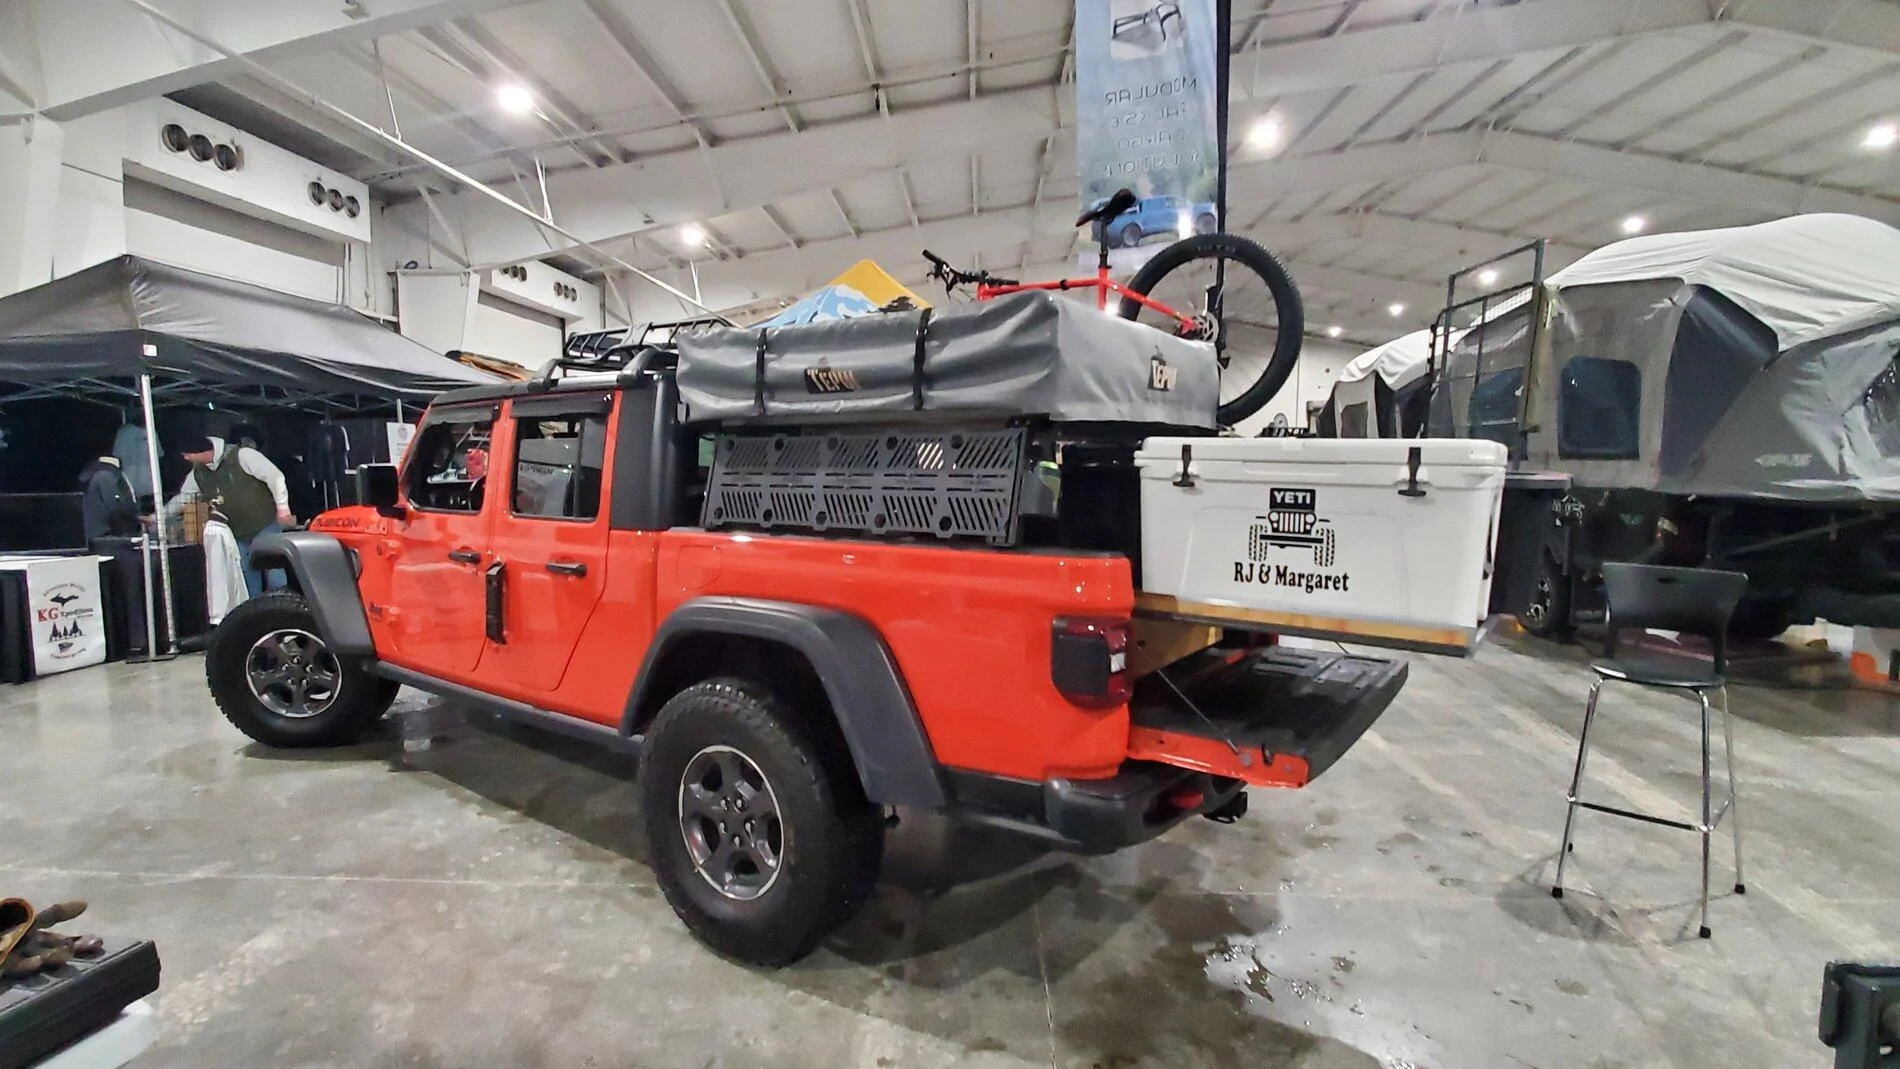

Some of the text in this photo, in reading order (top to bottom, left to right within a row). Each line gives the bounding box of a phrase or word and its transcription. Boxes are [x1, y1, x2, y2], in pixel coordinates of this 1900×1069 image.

[1273, 490, 1312, 505] YETI
[1233, 561, 1350, 594] RJ & Margaret
[37, 607, 59, 622] KG
